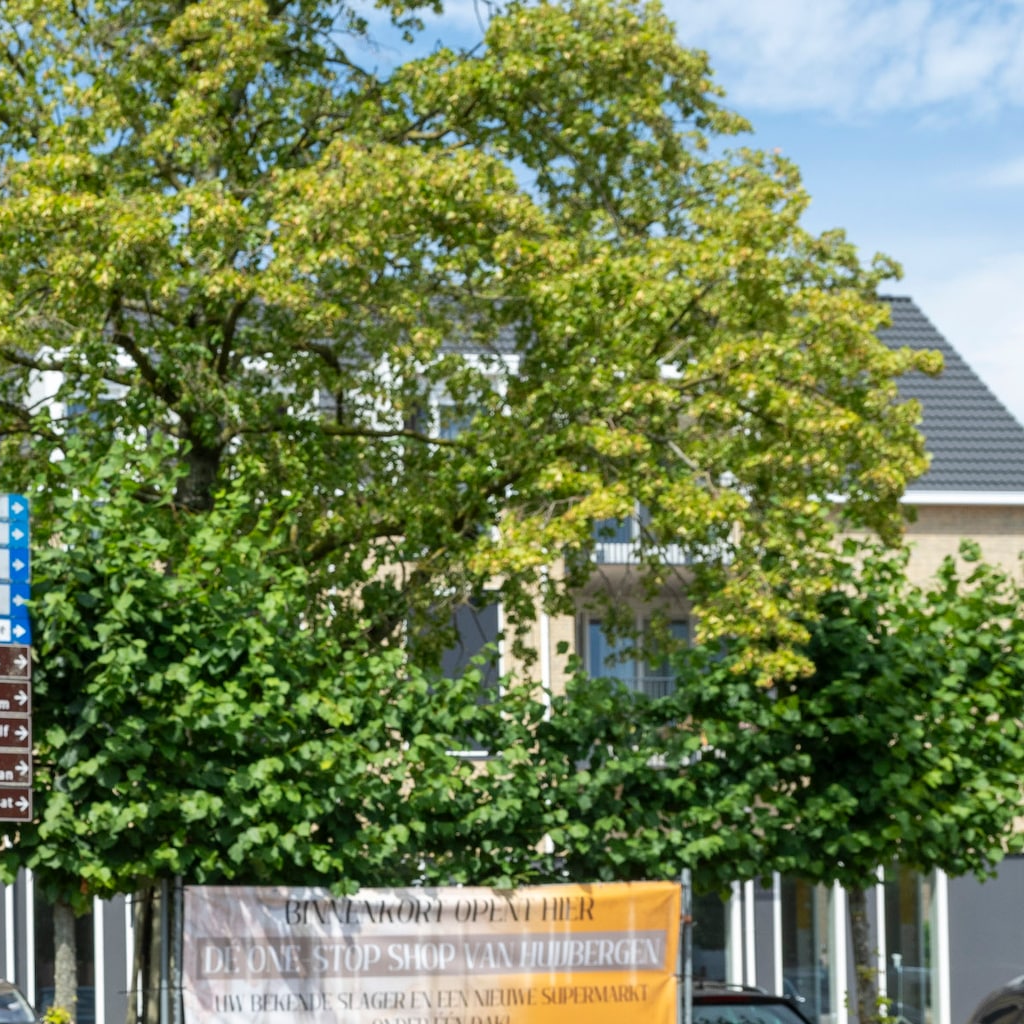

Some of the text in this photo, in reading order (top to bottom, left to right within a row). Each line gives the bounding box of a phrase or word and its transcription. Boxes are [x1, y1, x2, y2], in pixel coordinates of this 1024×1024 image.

[285, 895, 595, 925] BINNENKORT OPENT HIER
[204, 945, 240, 975] DE
[387, 942, 456, 972] SHOP
[463, 940, 514, 970] VAN
[519, 937, 660, 969] HUIJBERGEN
[214, 984, 649, 1013] UW BEKENDE SLAGER EN EEN NIEUWE SUPERMARKT
